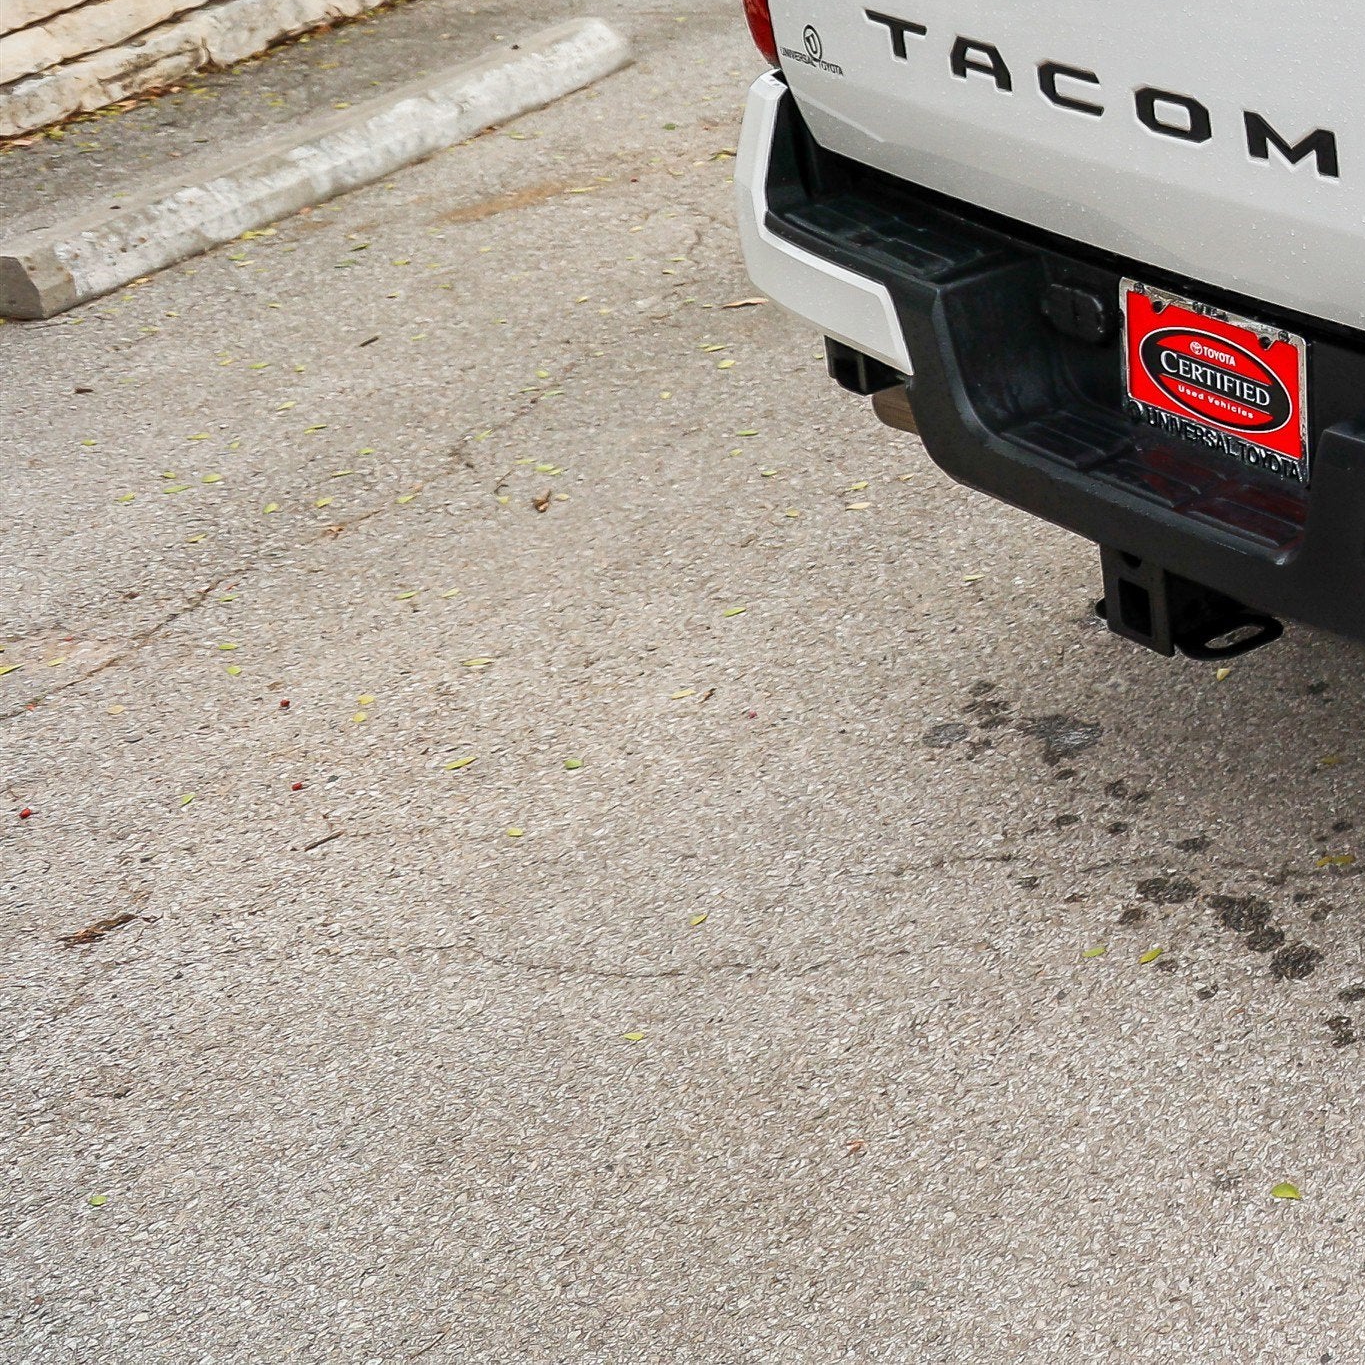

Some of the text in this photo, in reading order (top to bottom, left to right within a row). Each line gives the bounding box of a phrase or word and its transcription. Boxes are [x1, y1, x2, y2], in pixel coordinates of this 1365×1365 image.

[1160, 349, 1271, 407] CERTIFIED
[1202, 346, 1236, 367] TOYOTA
[1177, 384, 1254, 420] Used Vehicles
[1149, 407, 1304, 483] UNIVERSAL TOYOTA
